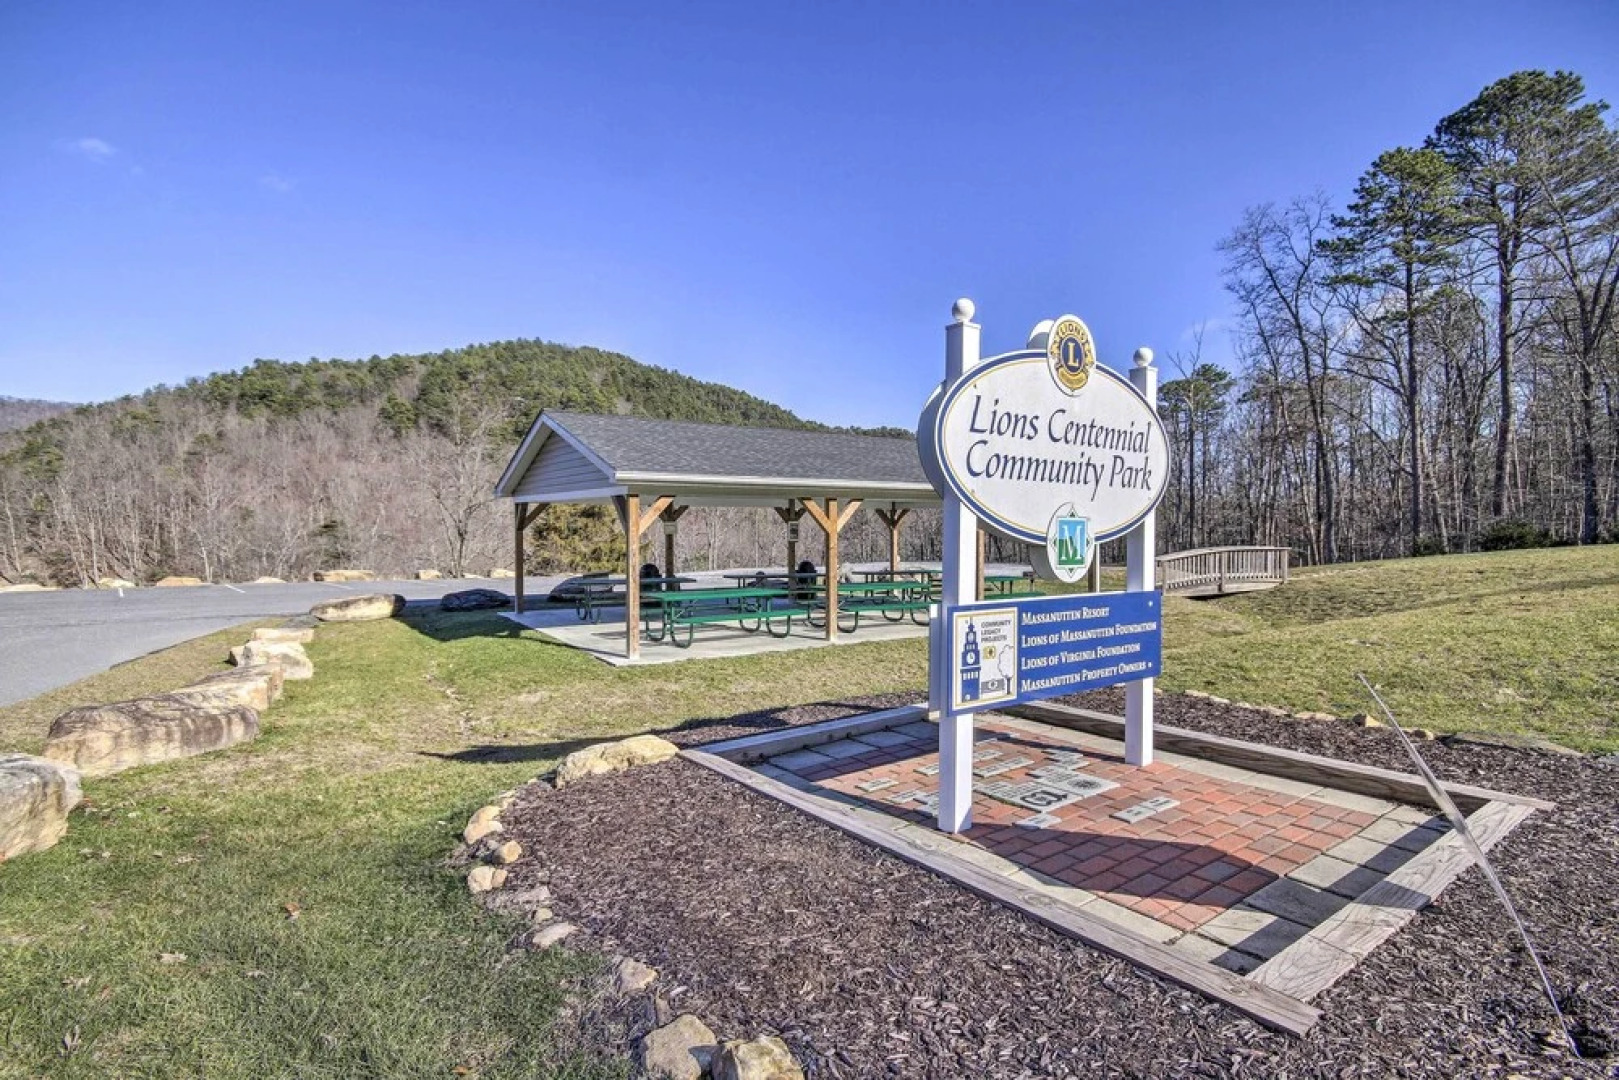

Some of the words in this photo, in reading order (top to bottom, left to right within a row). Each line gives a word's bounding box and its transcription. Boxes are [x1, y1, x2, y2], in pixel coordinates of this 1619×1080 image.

[1067, 342, 1079, 367] L
[969, 395, 1039, 440] Lions
[1048, 409, 1151, 454] Centennial
[966, 440, 1105, 502] Community
[1109, 455, 1152, 491] Park
[1060, 524, 1083, 561] M
[1021, 609, 1081, 625] MASSANUTTEN
[1082, 606, 1110, 620] RESORT
[1021, 635, 1048, 648] LIONS
[1048, 633, 1060, 644] OF
[1115, 621, 1157, 636] FOUNDATION
[1021, 657, 1048, 670] LIONS
[1048, 655, 1060, 666] OF
[1060, 649, 1096, 664] VIRGINIA
[1096, 643, 1141, 658] FOUNDATION
[1021, 672, 1081, 692] MASSANUTTEN
[1081, 666, 1118, 681] PROPERTY
[1118, 661, 1147, 675] OWNERS
